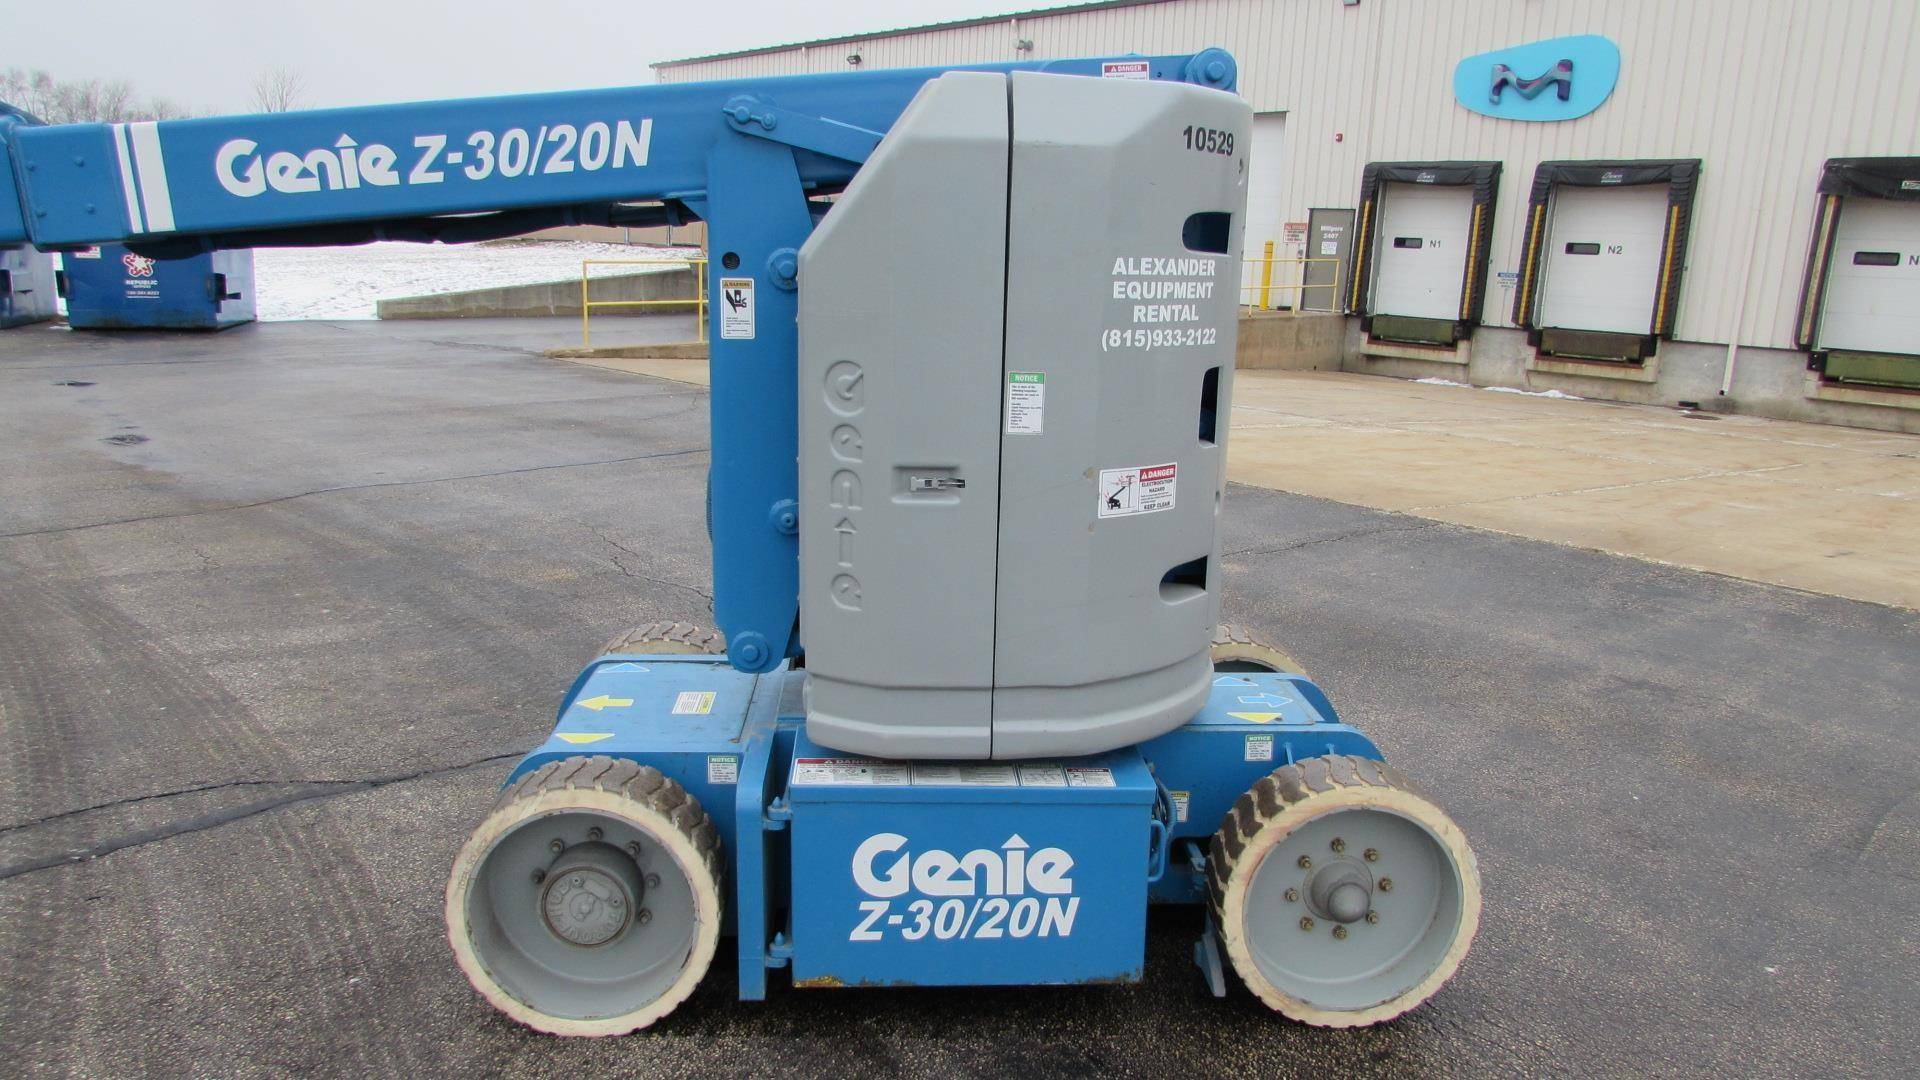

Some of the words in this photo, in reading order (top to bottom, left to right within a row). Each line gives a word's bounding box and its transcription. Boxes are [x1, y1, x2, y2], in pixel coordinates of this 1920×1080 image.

[1183, 125, 1234, 156] 10529
[215, 133, 401, 198] Genie
[408, 118, 653, 185] Z-30/20N
[1429, 239, 1441, 248] N1
[1607, 245, 1623, 255] N2
[1112, 257, 1216, 276] ALEXANDER
[1113, 281, 1214, 300] EQUIPMENT
[1133, 304, 1199, 322] RENTAL
[1101, 328, 1216, 352] (815)933-2122
[1148, 467, 1174, 479] DANGER
[1142, 478, 1173, 488] ELECTROCUTION
[852, 832, 1075, 898] Genie
[849, 897, 1081, 941] Z-30/20N
